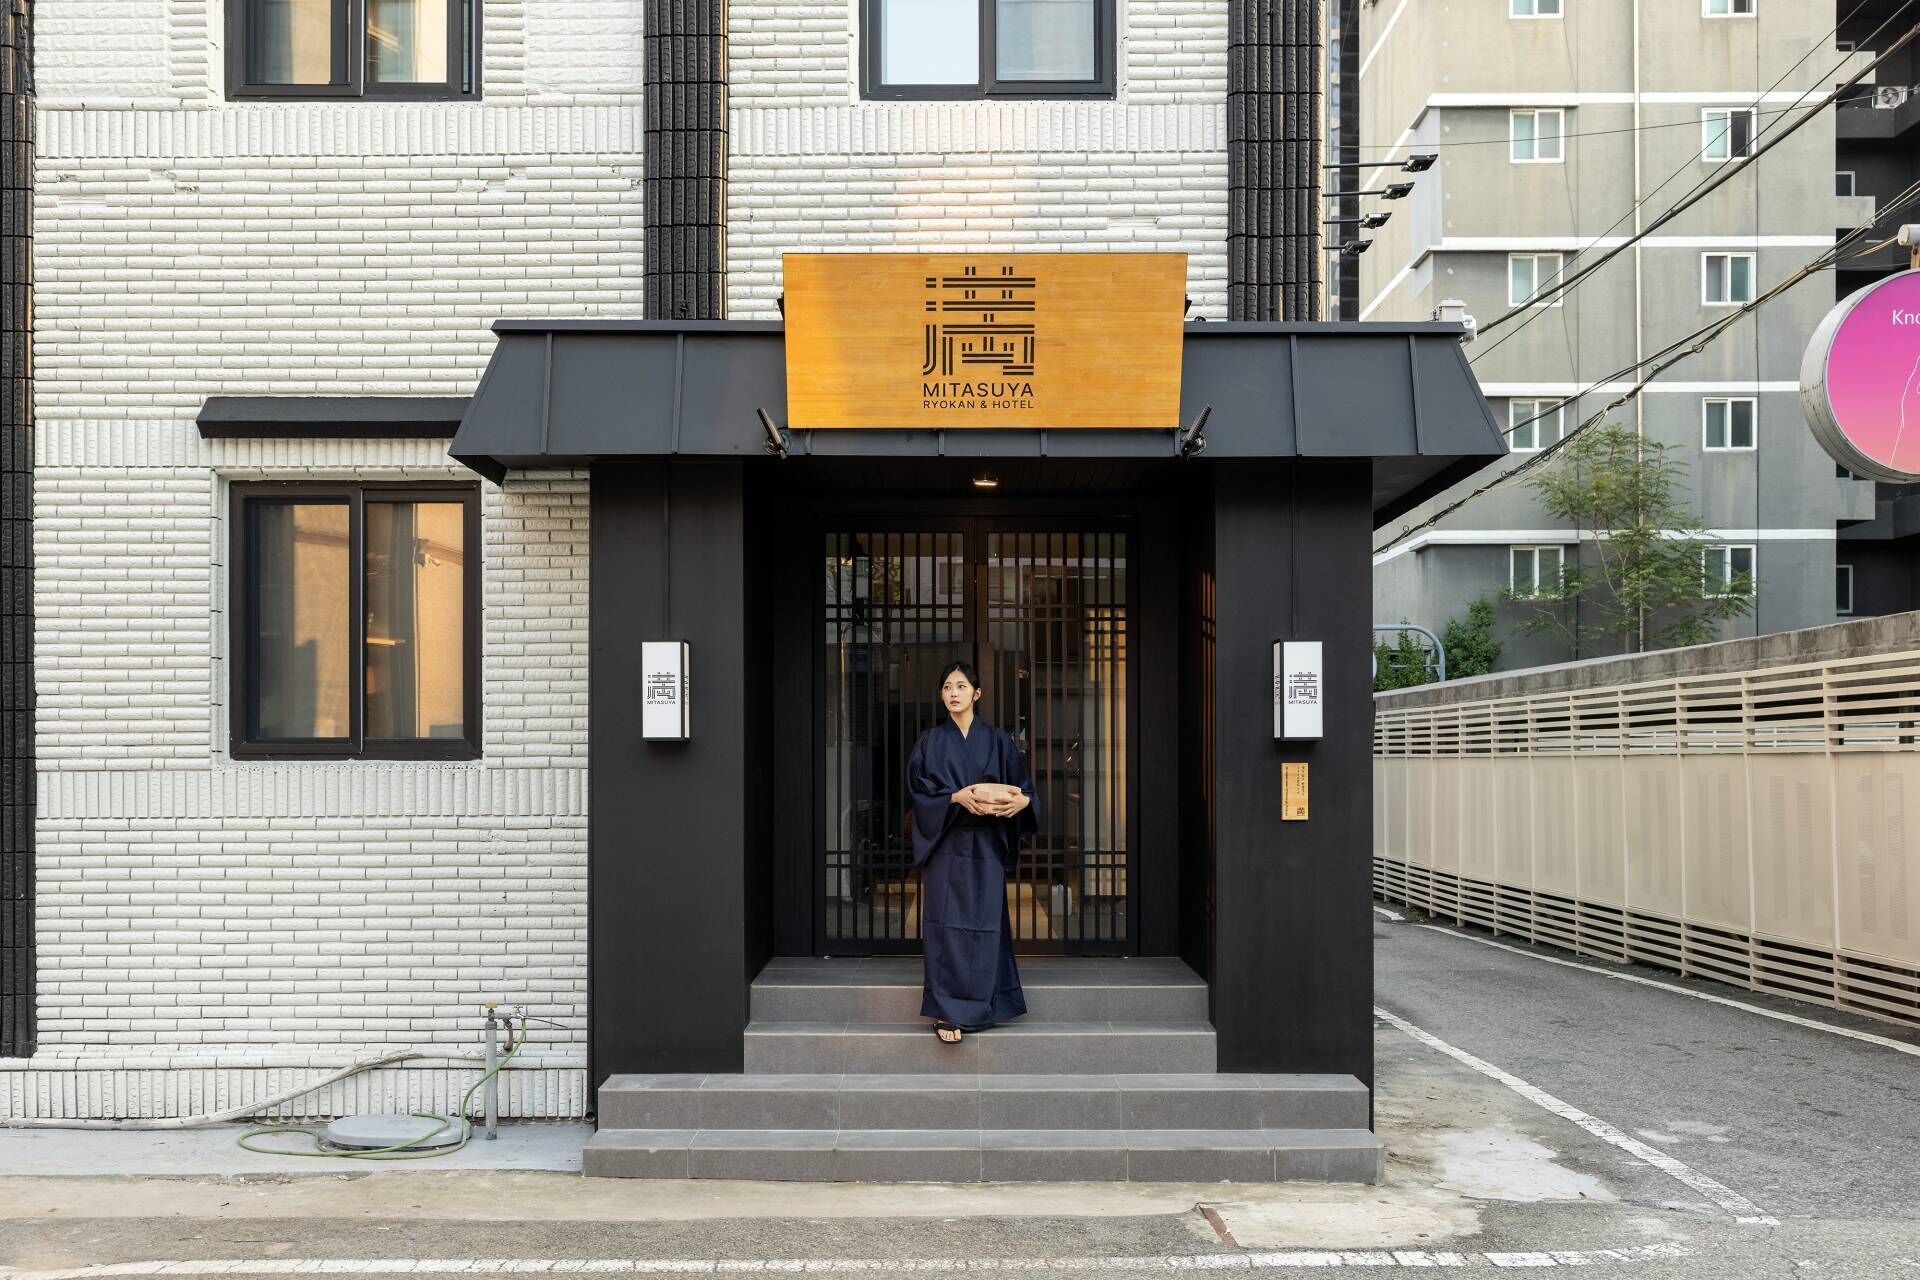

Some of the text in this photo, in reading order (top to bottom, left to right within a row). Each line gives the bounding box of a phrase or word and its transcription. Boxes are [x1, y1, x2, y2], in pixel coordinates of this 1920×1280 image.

[923, 382, 1034, 398] MITASUYA
[923, 400, 1034, 409] RYOKAN & HOTEL
